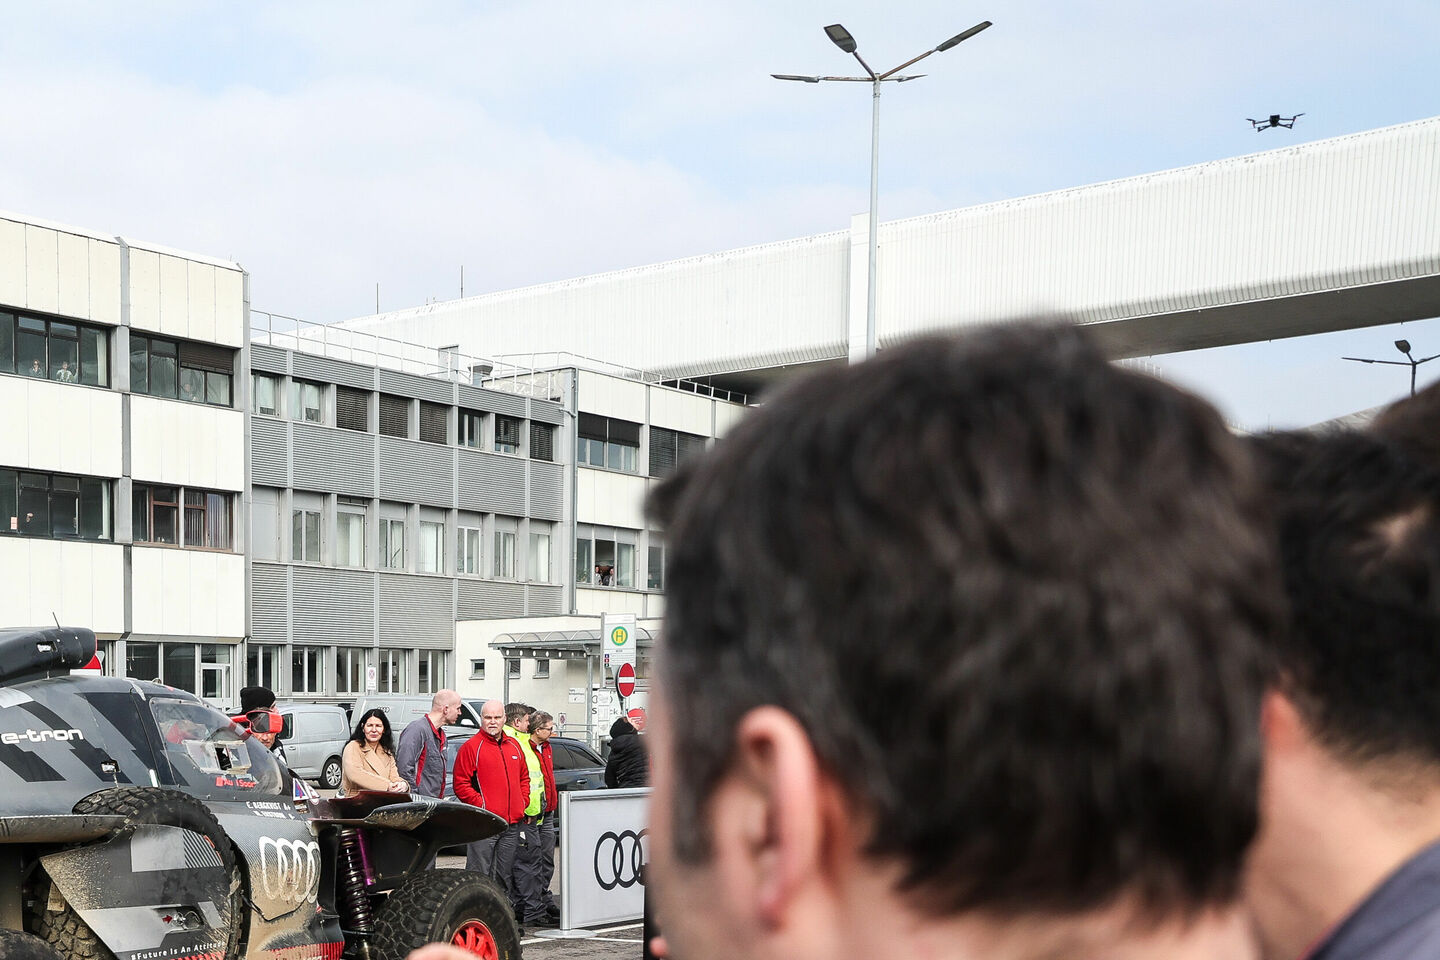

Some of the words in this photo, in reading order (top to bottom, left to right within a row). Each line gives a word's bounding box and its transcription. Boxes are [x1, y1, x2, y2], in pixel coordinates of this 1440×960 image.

[615, 630, 624, 642] H
[0, 728, 84, 745] e-tron
[130, 950, 168, 960] #Future
[170, 947, 178, 955] Is
[181, 946, 192, 954] An
